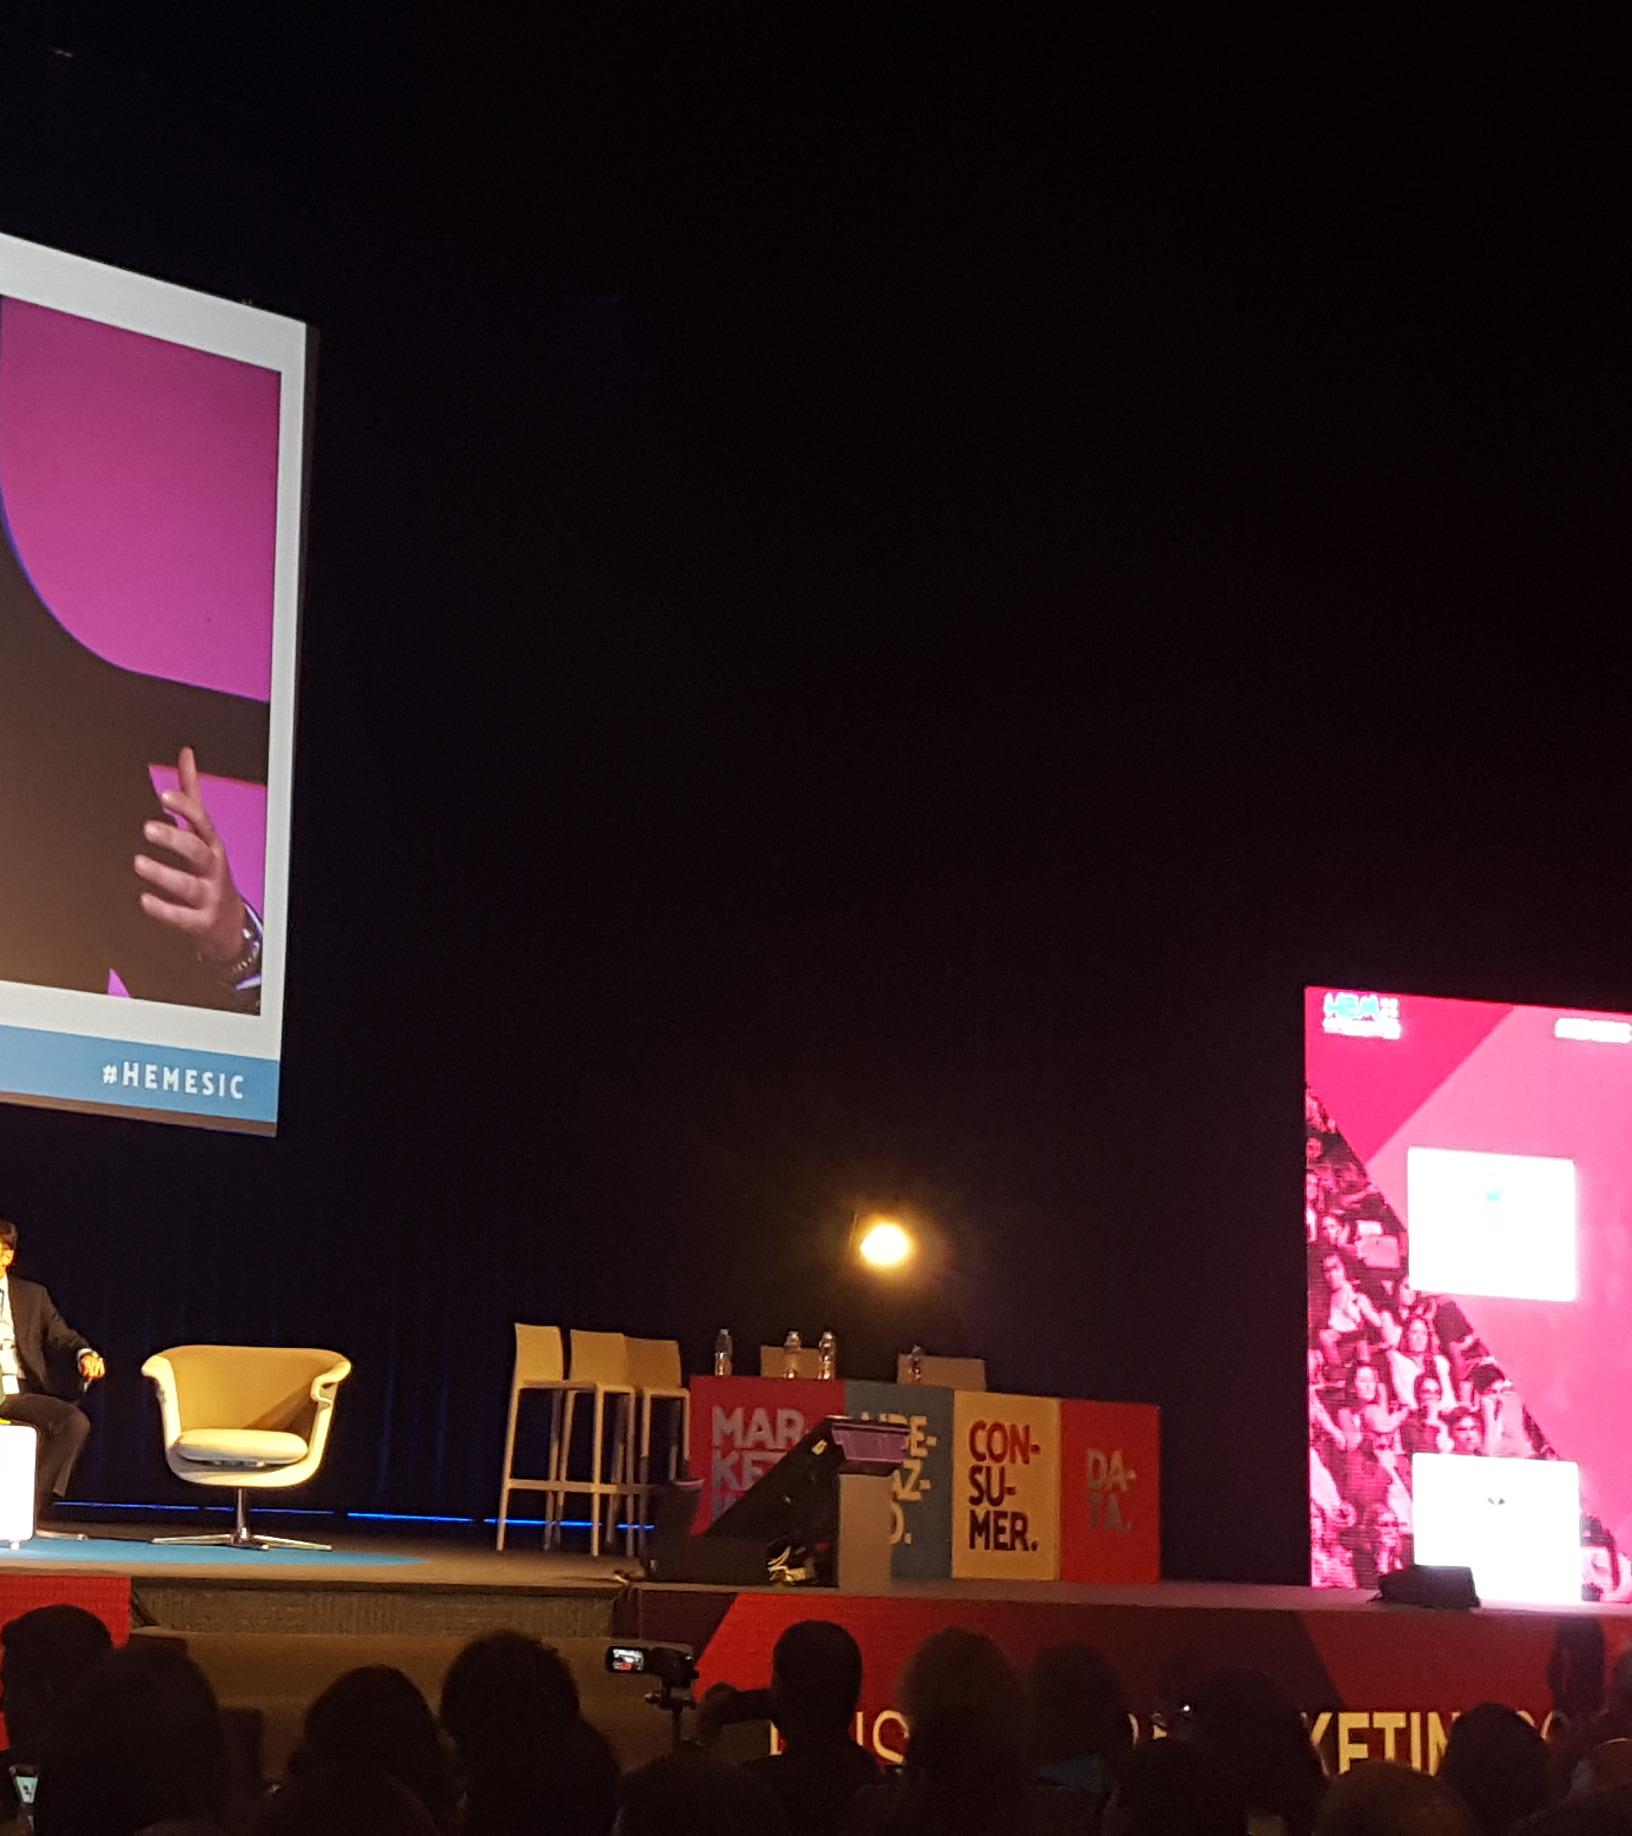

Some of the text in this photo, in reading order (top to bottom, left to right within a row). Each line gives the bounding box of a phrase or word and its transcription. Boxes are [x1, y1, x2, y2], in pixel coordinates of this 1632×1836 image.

[101, 1061, 245, 1100] #HEMESIC
[711, 1405, 810, 1449] MAR
[968, 1420, 1041, 1465] CON-
[968, 1464, 1017, 1507] SU-
[1085, 1448, 1137, 1492] DA-
[968, 1509, 1039, 1554] MER.
[1086, 1492, 1133, 1534] TA.
